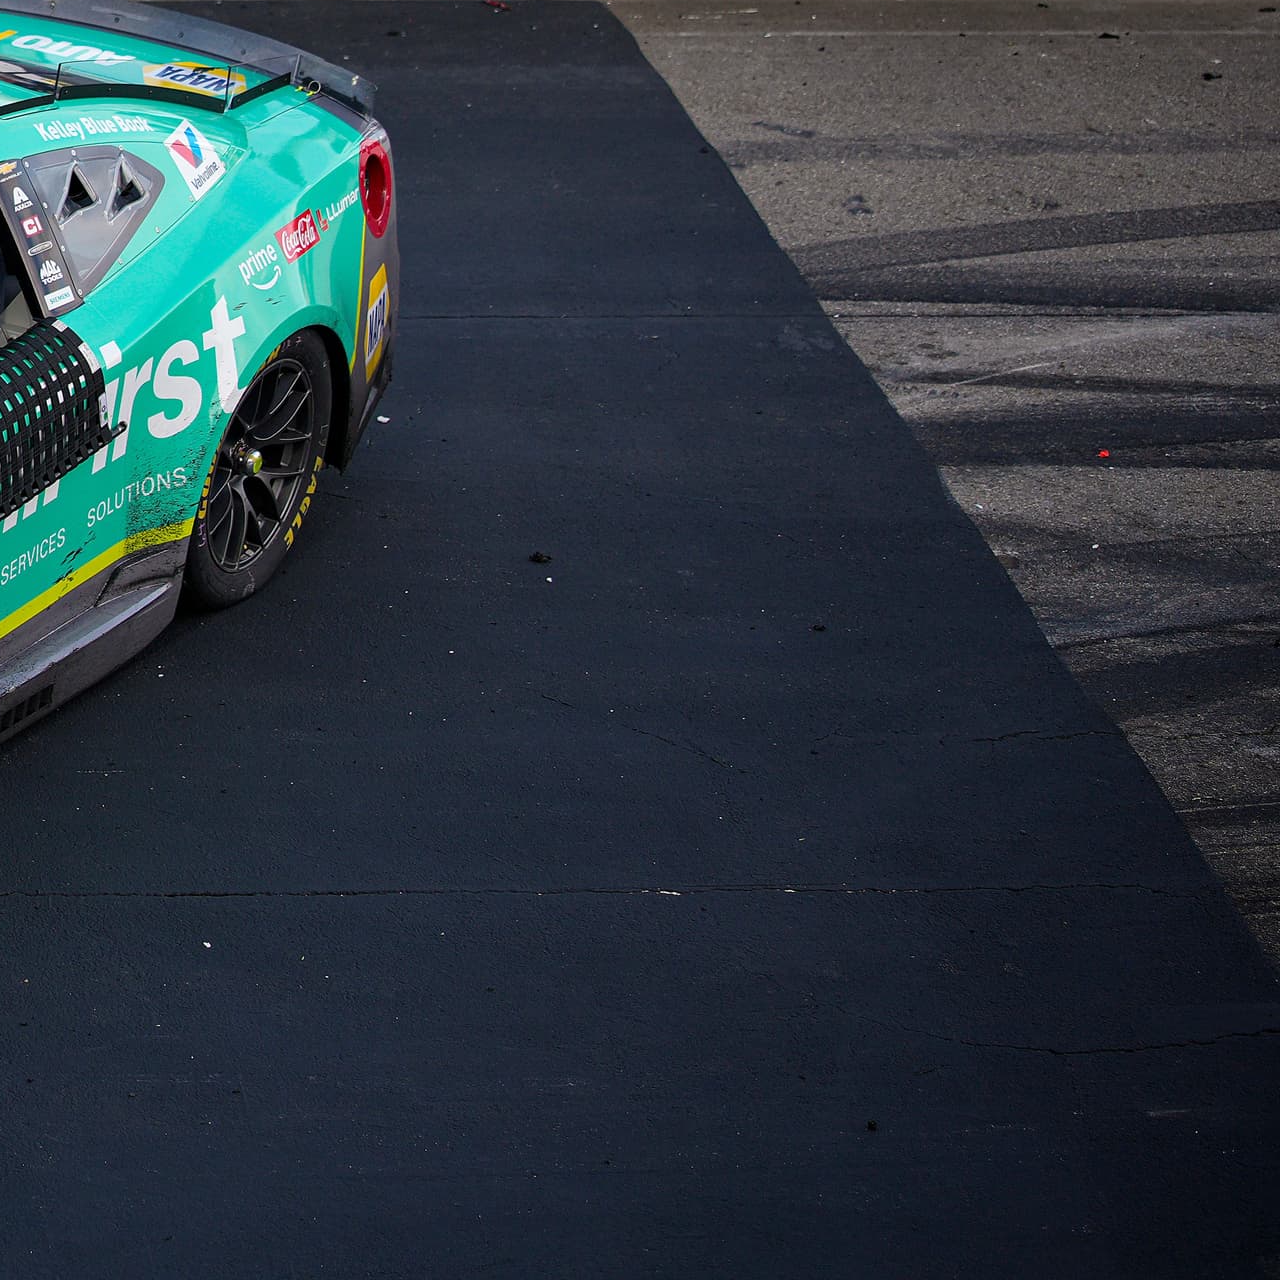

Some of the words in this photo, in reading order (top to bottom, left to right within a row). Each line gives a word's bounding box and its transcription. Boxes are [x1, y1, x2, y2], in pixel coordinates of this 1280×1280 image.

[10, 33, 138, 66] AUTO
[34, 120, 86, 142] Kelley
[80, 116, 112, 136] Blue
[191, 161, 220, 191] Valvoline
[325, 187, 360, 223] LLumar
[42, 272, 64, 286] TOOLS
[238, 242, 278, 286] prime
[366, 290, 387, 358] NAPA
[283, 455, 324, 551] EAGLE
[0, 527, 68, 586] SERVICES
[86, 466, 188, 528] SOLUTIONS
